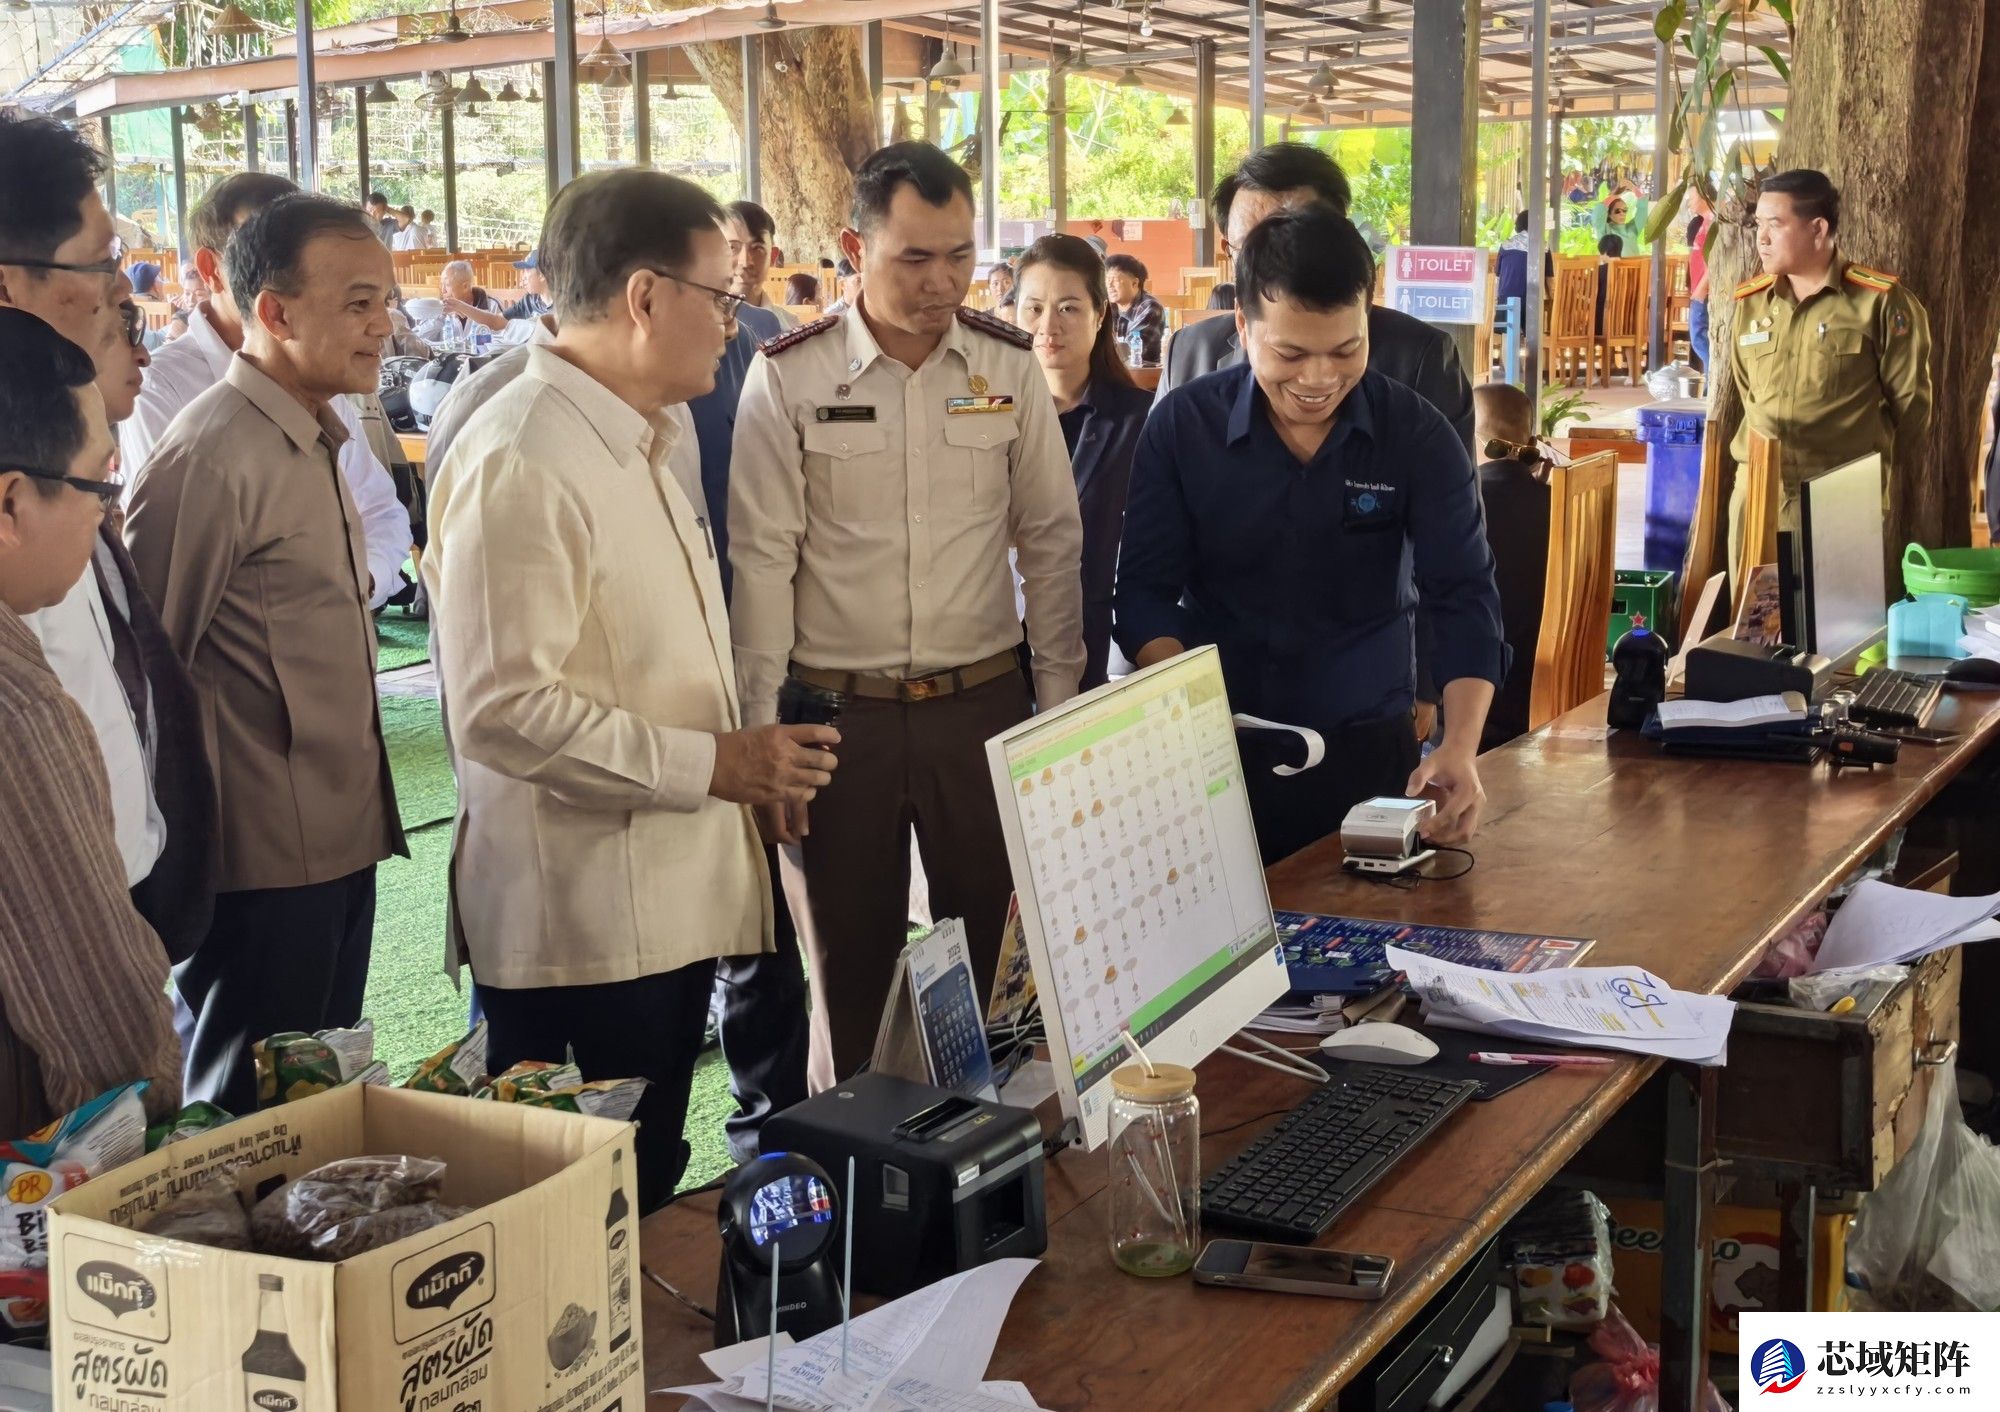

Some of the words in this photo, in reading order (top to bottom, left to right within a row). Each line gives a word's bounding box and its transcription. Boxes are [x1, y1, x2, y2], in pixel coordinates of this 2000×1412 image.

[1418, 258, 1472, 272] TOILET
[1416, 295, 1471, 309] TOILET
[72, 1343, 169, 1400] สูตรผัด
[400, 1311, 493, 1412] สูตรผัด
[419, 1363, 489, 1411] กลมกล่อม
